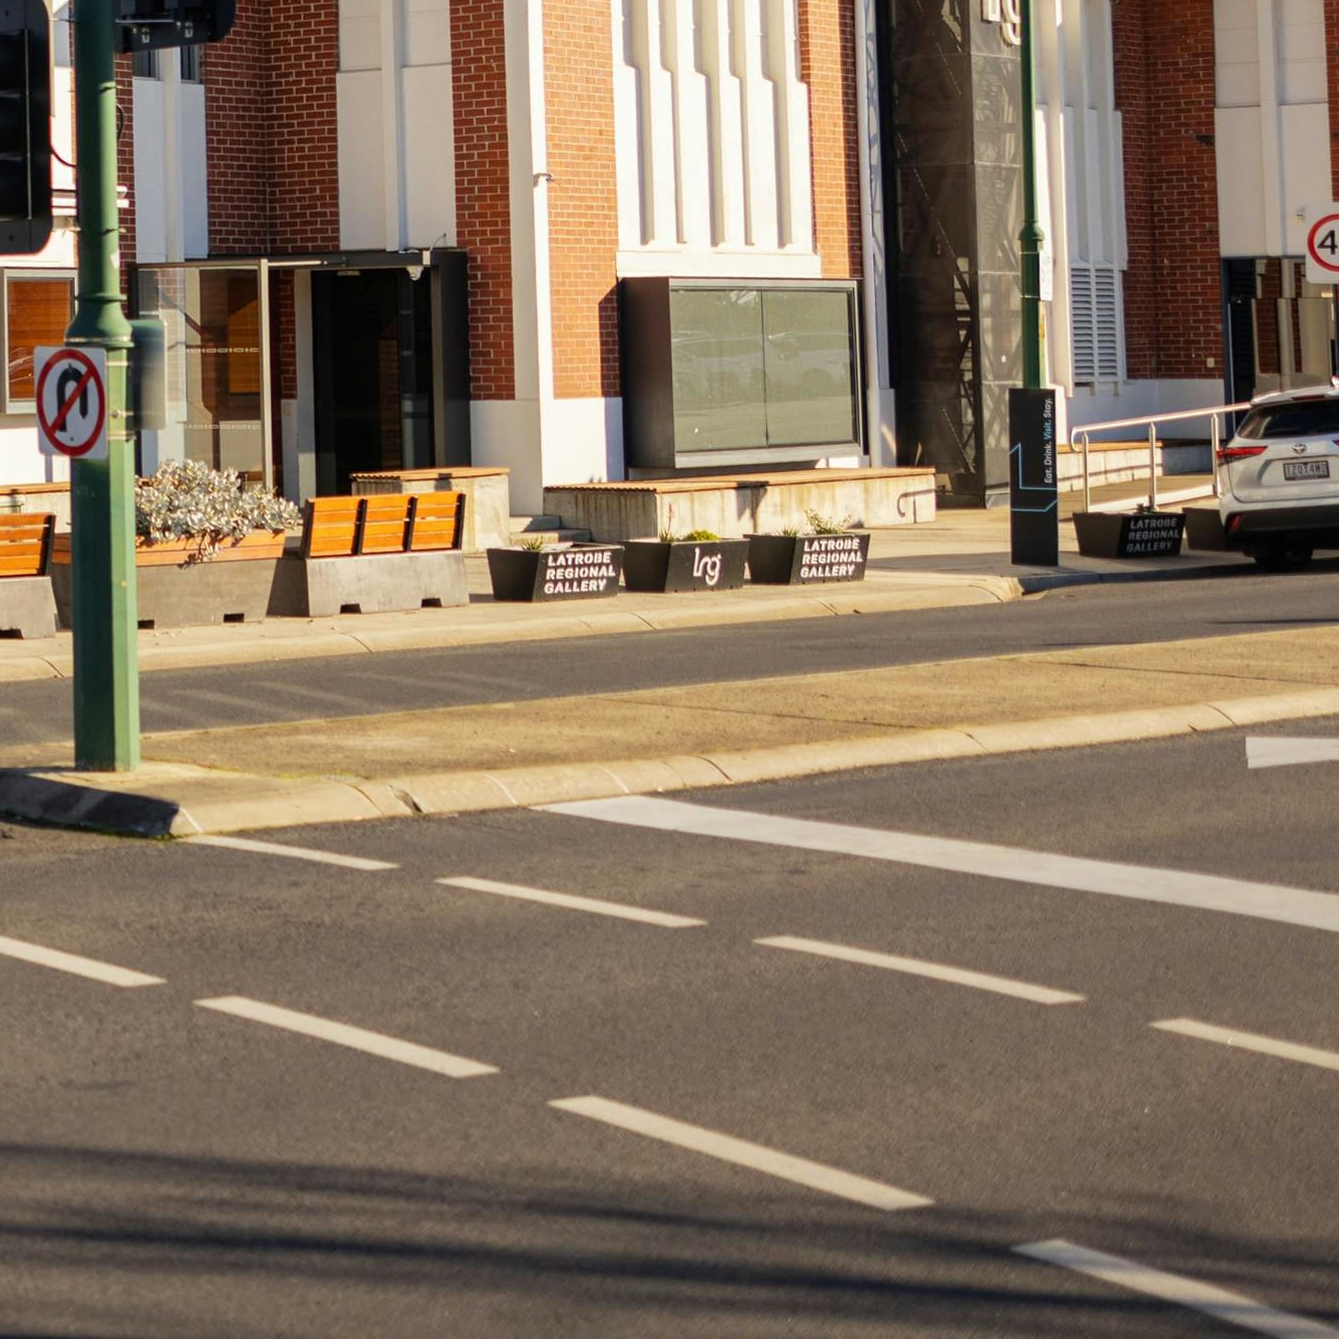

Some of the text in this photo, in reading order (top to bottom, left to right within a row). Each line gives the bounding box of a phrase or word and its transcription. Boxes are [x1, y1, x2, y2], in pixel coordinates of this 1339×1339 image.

[1317, 230, 1338, 255] 4
[1130, 518, 1177, 529] LATROBE
[1128, 529, 1179, 540] REGIONAL
[803, 538, 860, 552] LATROBE
[1126, 541, 1173, 553] GALLERY
[548, 551, 612, 566] LATROBE
[802, 551, 863, 565] REGIONAL
[546, 565, 616, 580] REGIONAL
[800, 564, 855, 578] GALLERY
[544, 579, 607, 594] GALLERY
